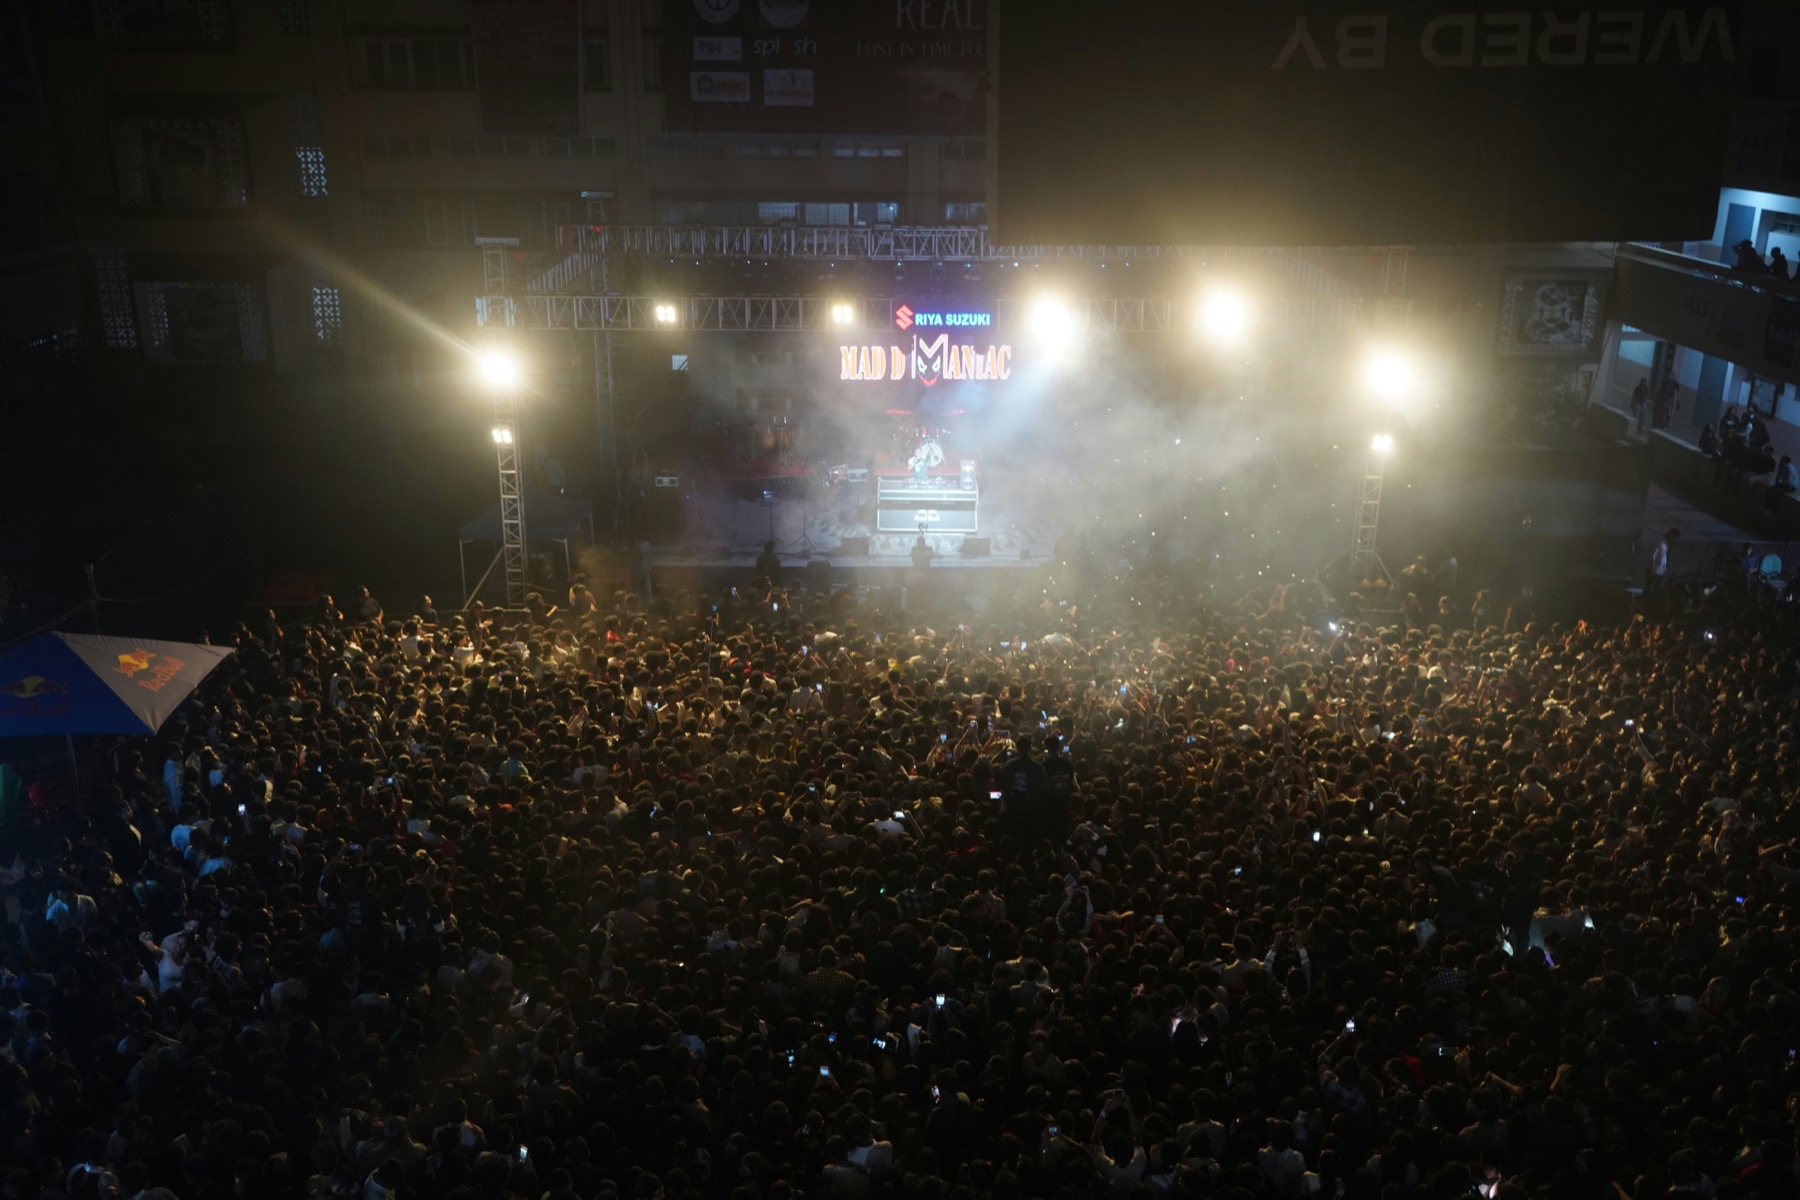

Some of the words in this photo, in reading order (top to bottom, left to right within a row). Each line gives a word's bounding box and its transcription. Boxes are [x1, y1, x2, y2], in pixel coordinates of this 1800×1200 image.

[896, 0, 983, 31] REAL
[900, 40, 914, 57] IN
[1270, 14, 1389, 70] BY
[1419, 7, 1736, 67] WERED
[915, 313, 943, 326] RIYA
[945, 313, 991, 326] SUZUKI
[840, 346, 887, 380] MAD
